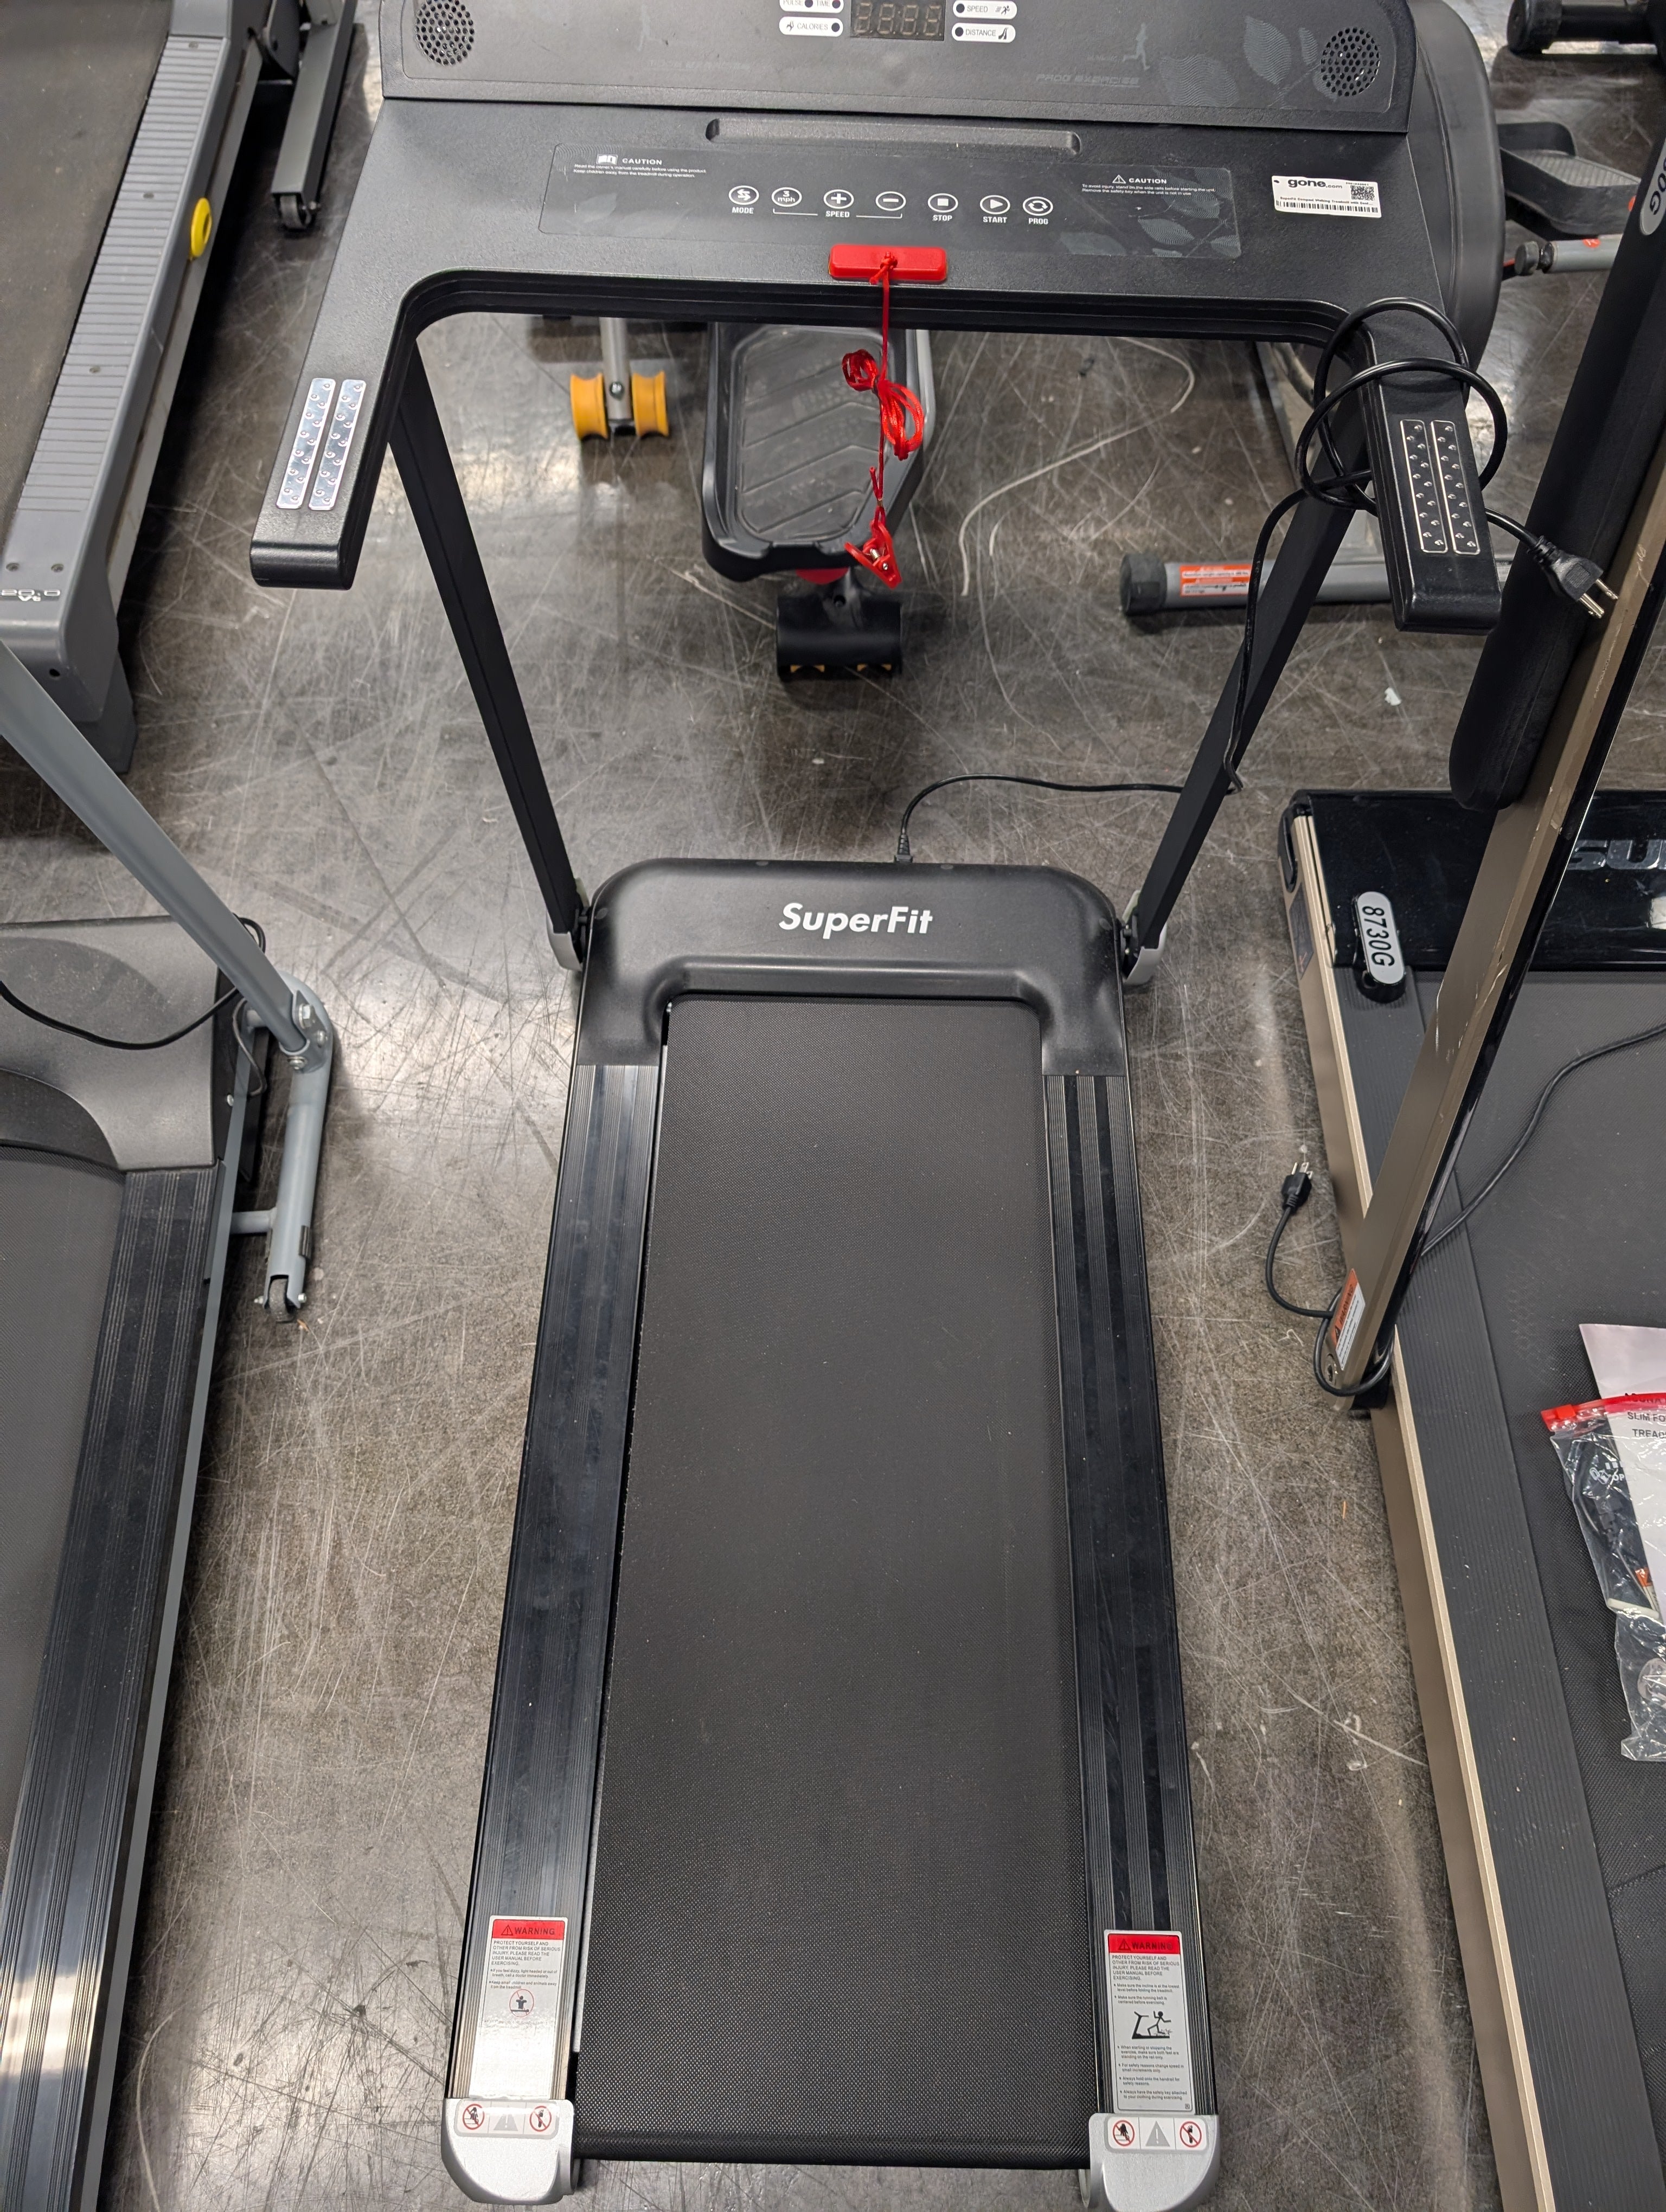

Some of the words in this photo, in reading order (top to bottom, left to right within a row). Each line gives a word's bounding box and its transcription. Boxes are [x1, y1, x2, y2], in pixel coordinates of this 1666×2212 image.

[967, 5, 988, 13] SPEED
[797, 22, 828, 30] CALORIES
[1287, 179, 1342, 189] gone.com
[1567, 839, 1666, 870] SU
[778, 902, 933, 939] SuperFit
[1362, 906, 1395, 967] 8730G
[1627, 1412, 1650, 1420] SLIM
[1653, 1413, 1666, 1422] FO
[1632, 1429, 1666, 1439] TREAD
[1132, 1942, 1173, 1950] WARNING
